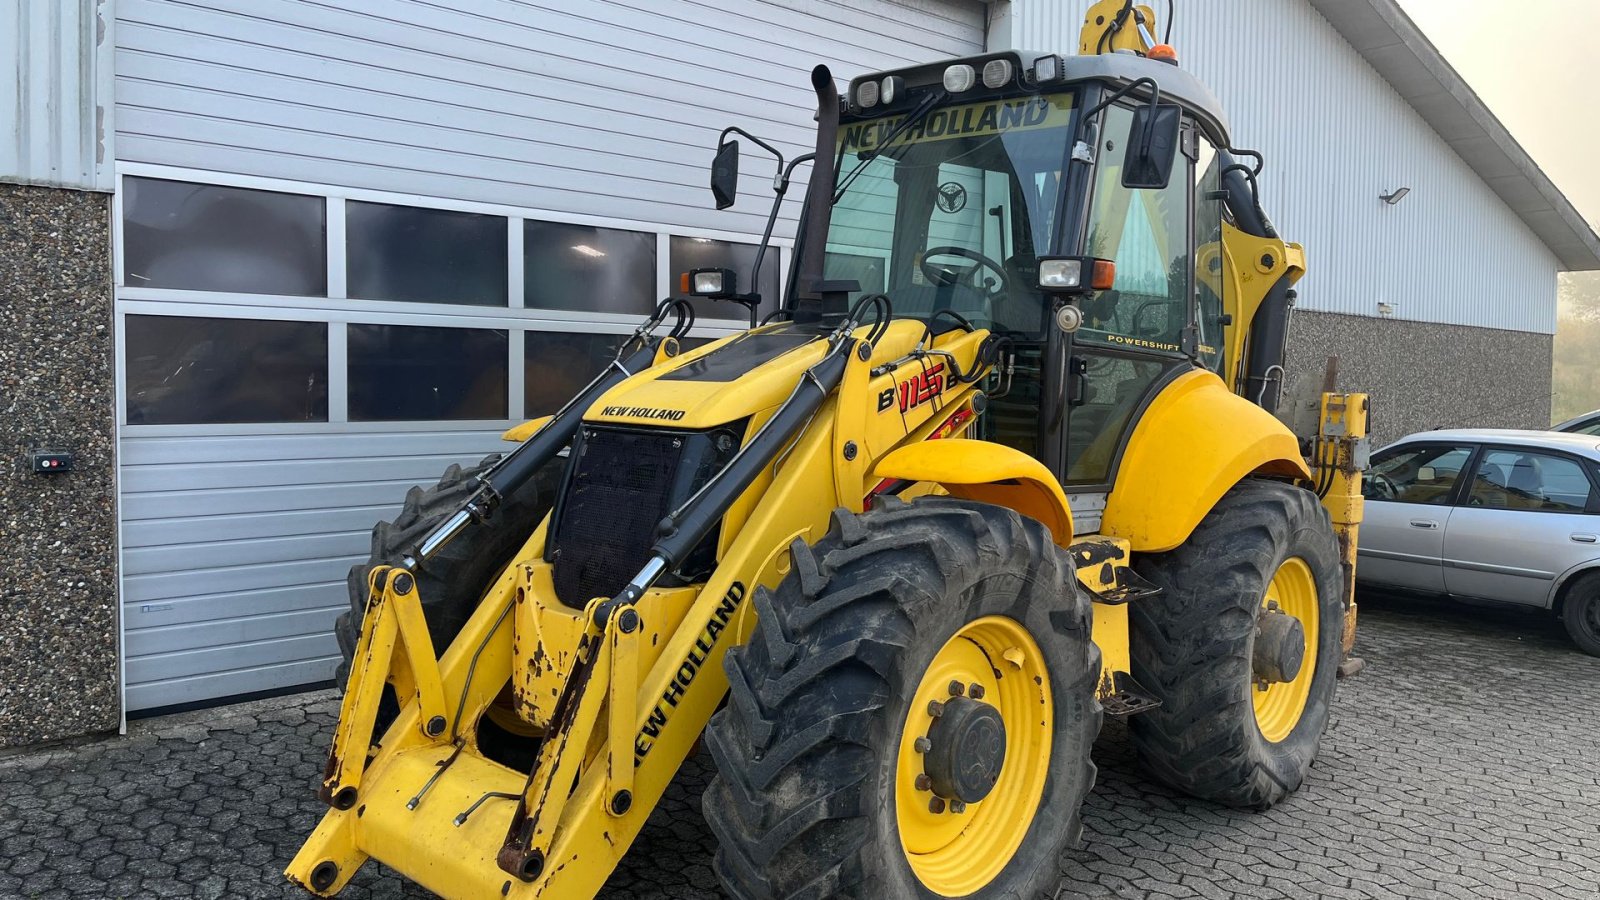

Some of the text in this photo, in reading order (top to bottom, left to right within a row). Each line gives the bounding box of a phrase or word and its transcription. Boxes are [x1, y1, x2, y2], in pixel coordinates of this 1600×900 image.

[904, 99, 1049, 142] HOLLAND
[1107, 334, 1180, 352] POWERSHIFT
[600, 406, 686, 421] NEW HOLLAND
[634, 580, 746, 768] EW HOLLAND
